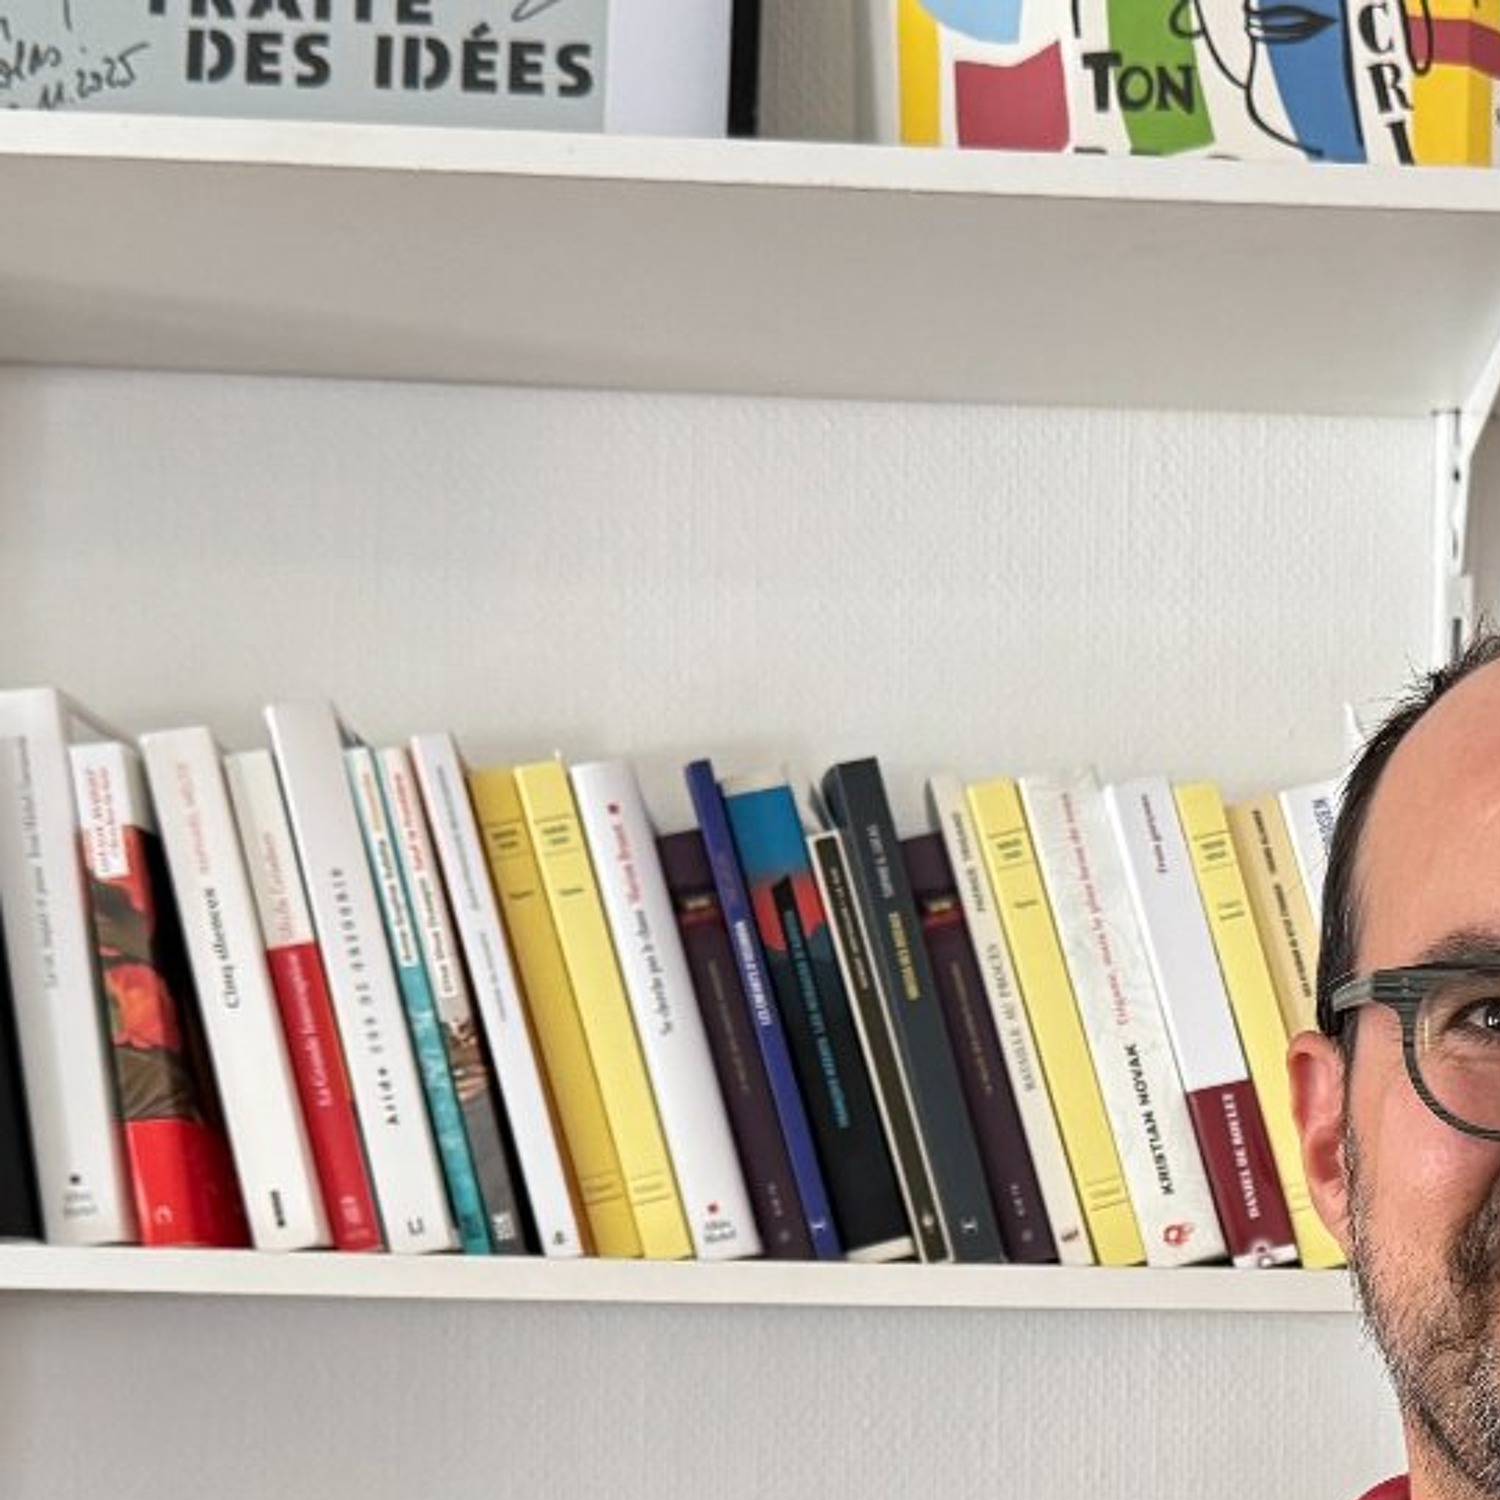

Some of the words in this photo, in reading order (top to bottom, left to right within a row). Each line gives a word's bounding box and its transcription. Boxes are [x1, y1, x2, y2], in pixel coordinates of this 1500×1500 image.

[186, 29, 332, 88] DES
[374, 22, 593, 97] IDÉES
[1082, 52, 1196, 113] TON
[1127, 1043, 1150, 1105] NOVAK
[1145, 1110, 1173, 1195] KRISTIAN
